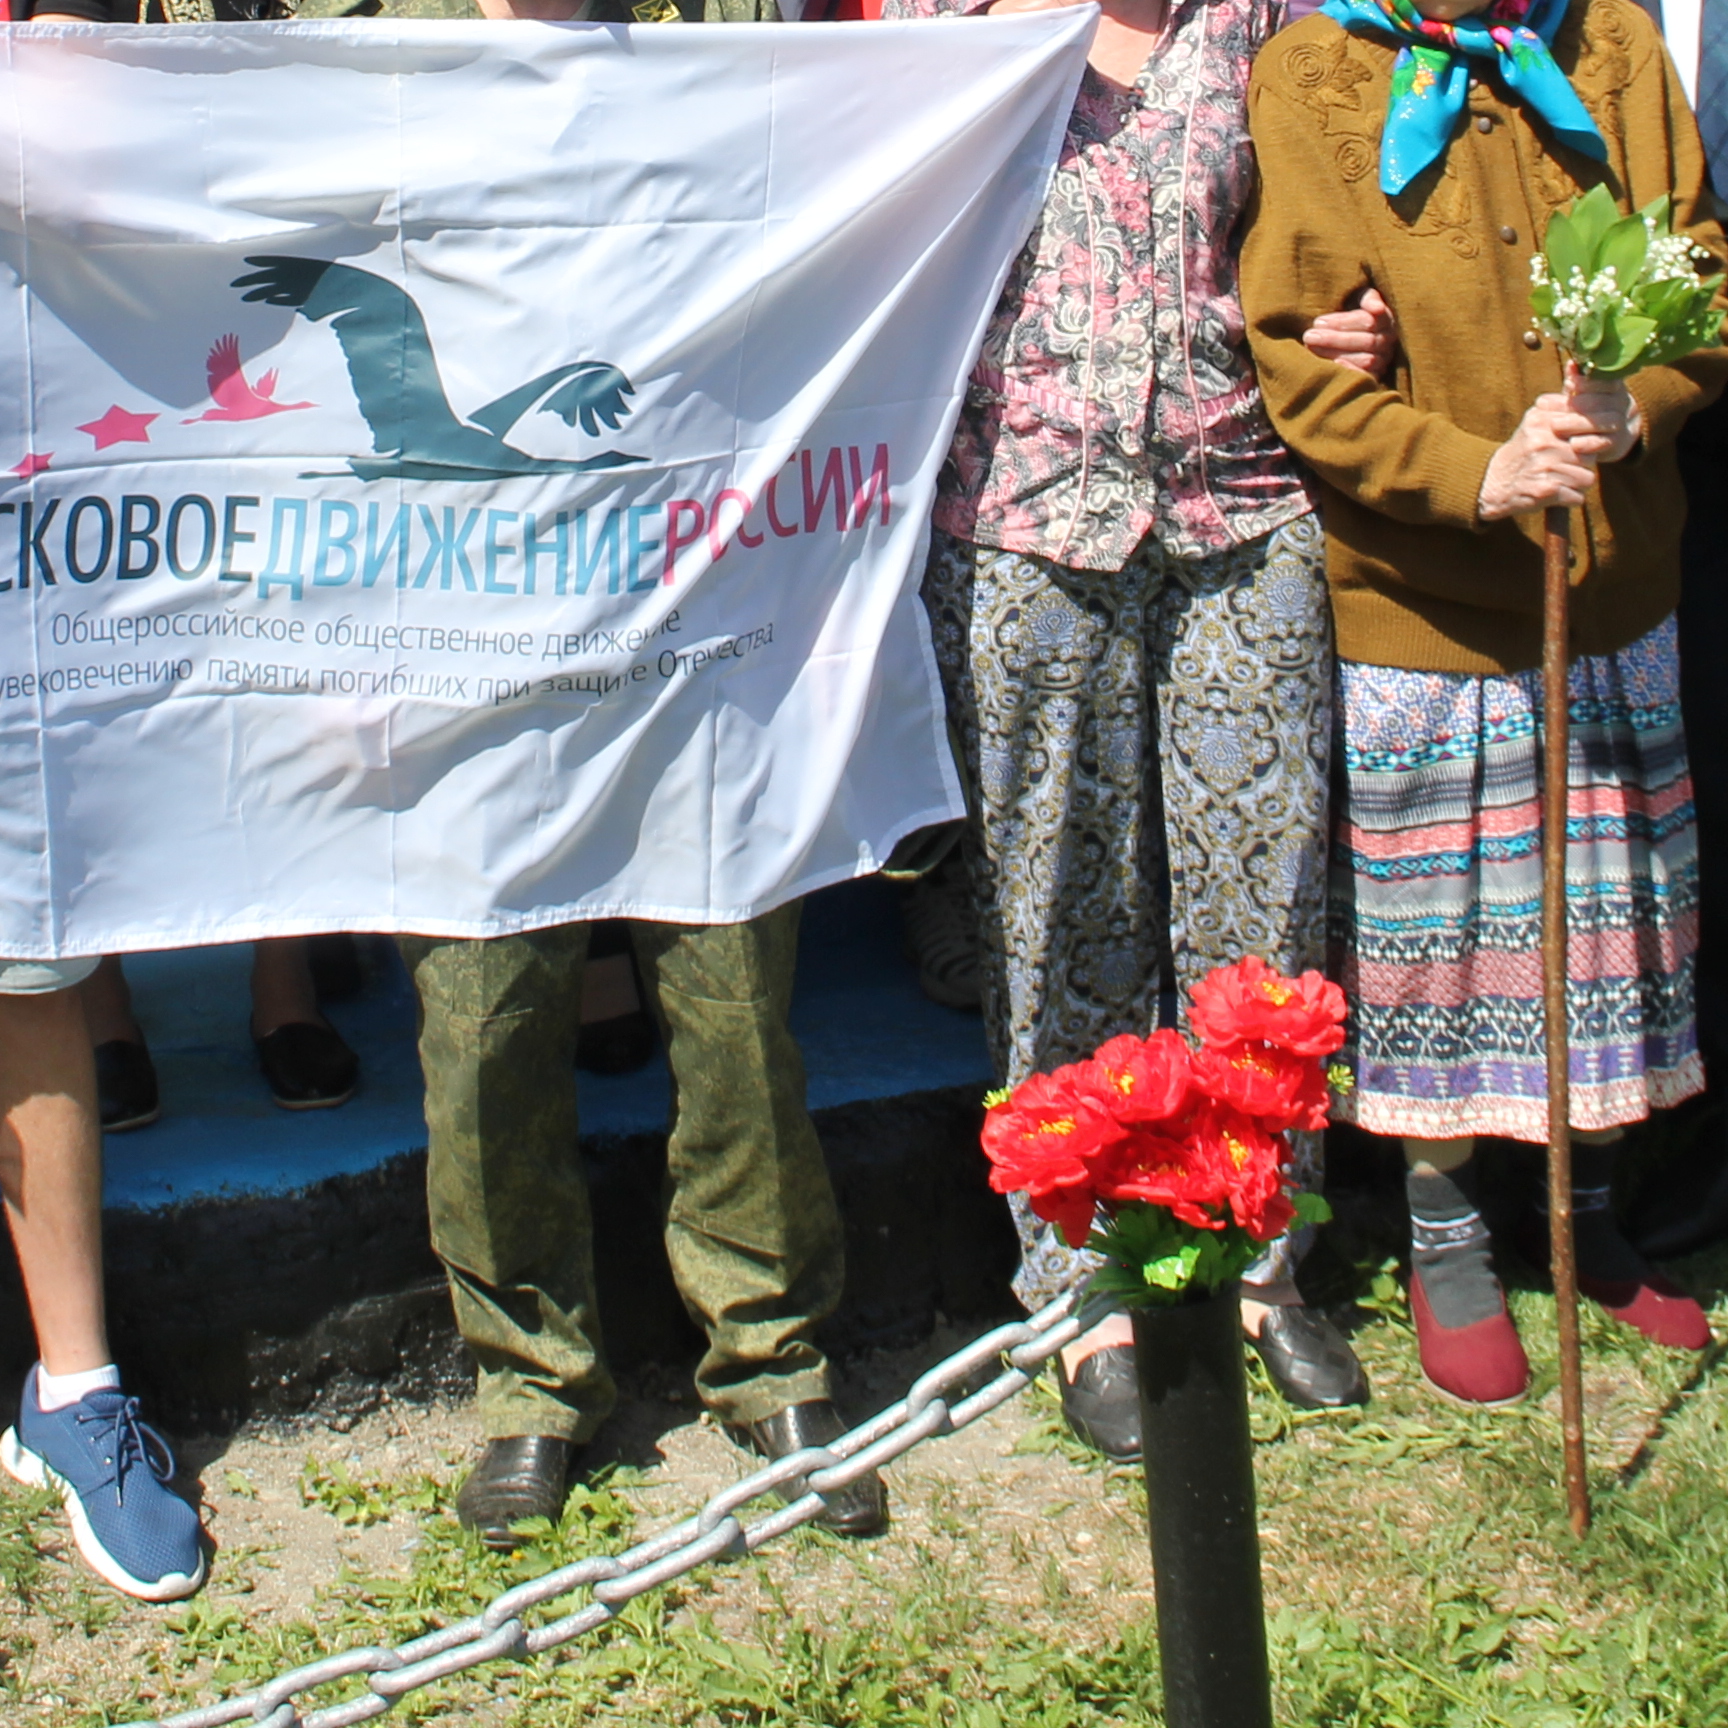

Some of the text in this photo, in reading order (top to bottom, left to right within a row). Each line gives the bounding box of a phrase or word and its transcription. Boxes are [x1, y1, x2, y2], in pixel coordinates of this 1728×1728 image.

[51, 608, 681, 661] Общероссийское общественное движее
[207, 658, 310, 689] памяти
[320, 663, 468, 699] погибших
[477, 677, 531, 706] при
[540, 663, 647, 698] защите
